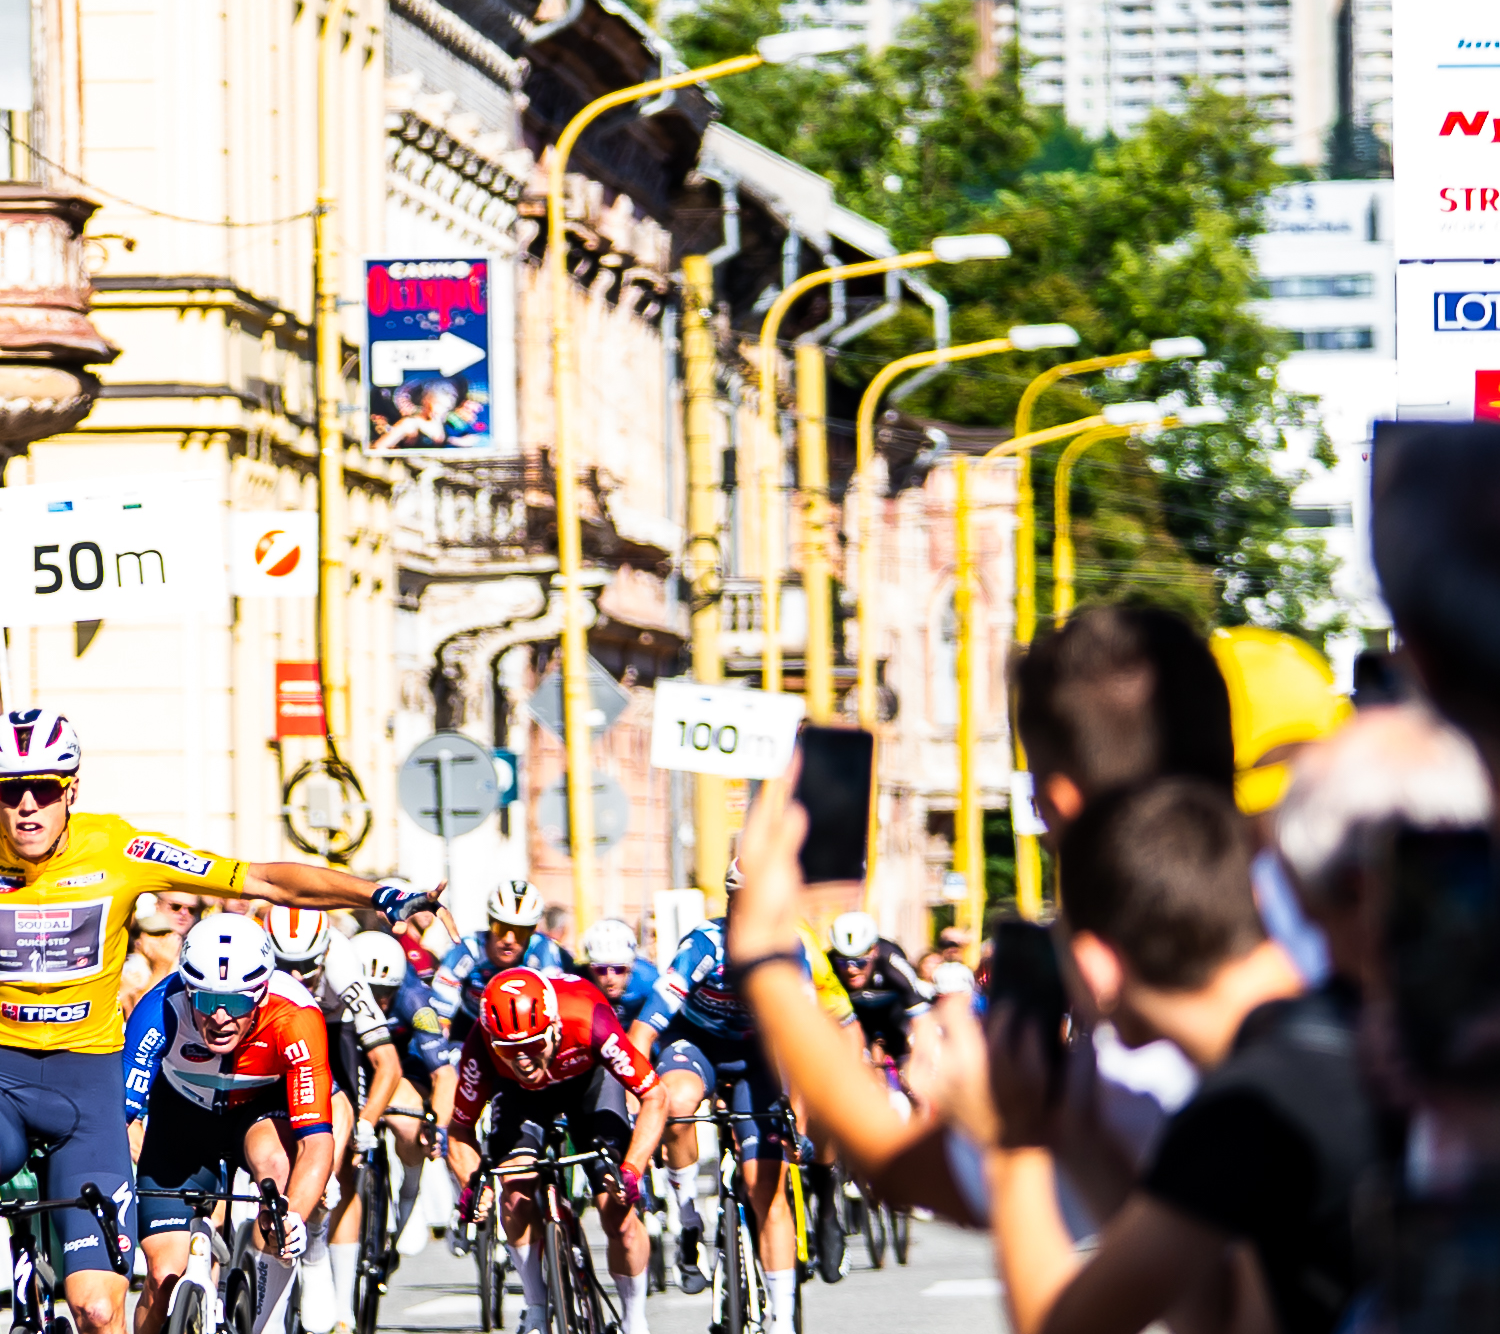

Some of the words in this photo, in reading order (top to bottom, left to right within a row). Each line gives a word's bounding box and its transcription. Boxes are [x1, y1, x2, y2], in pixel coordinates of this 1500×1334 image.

[150, 841, 211, 875] TIPOS
[17, 920, 69, 930] SOUDAL
[22, 1004, 88, 1022] TIPOS
